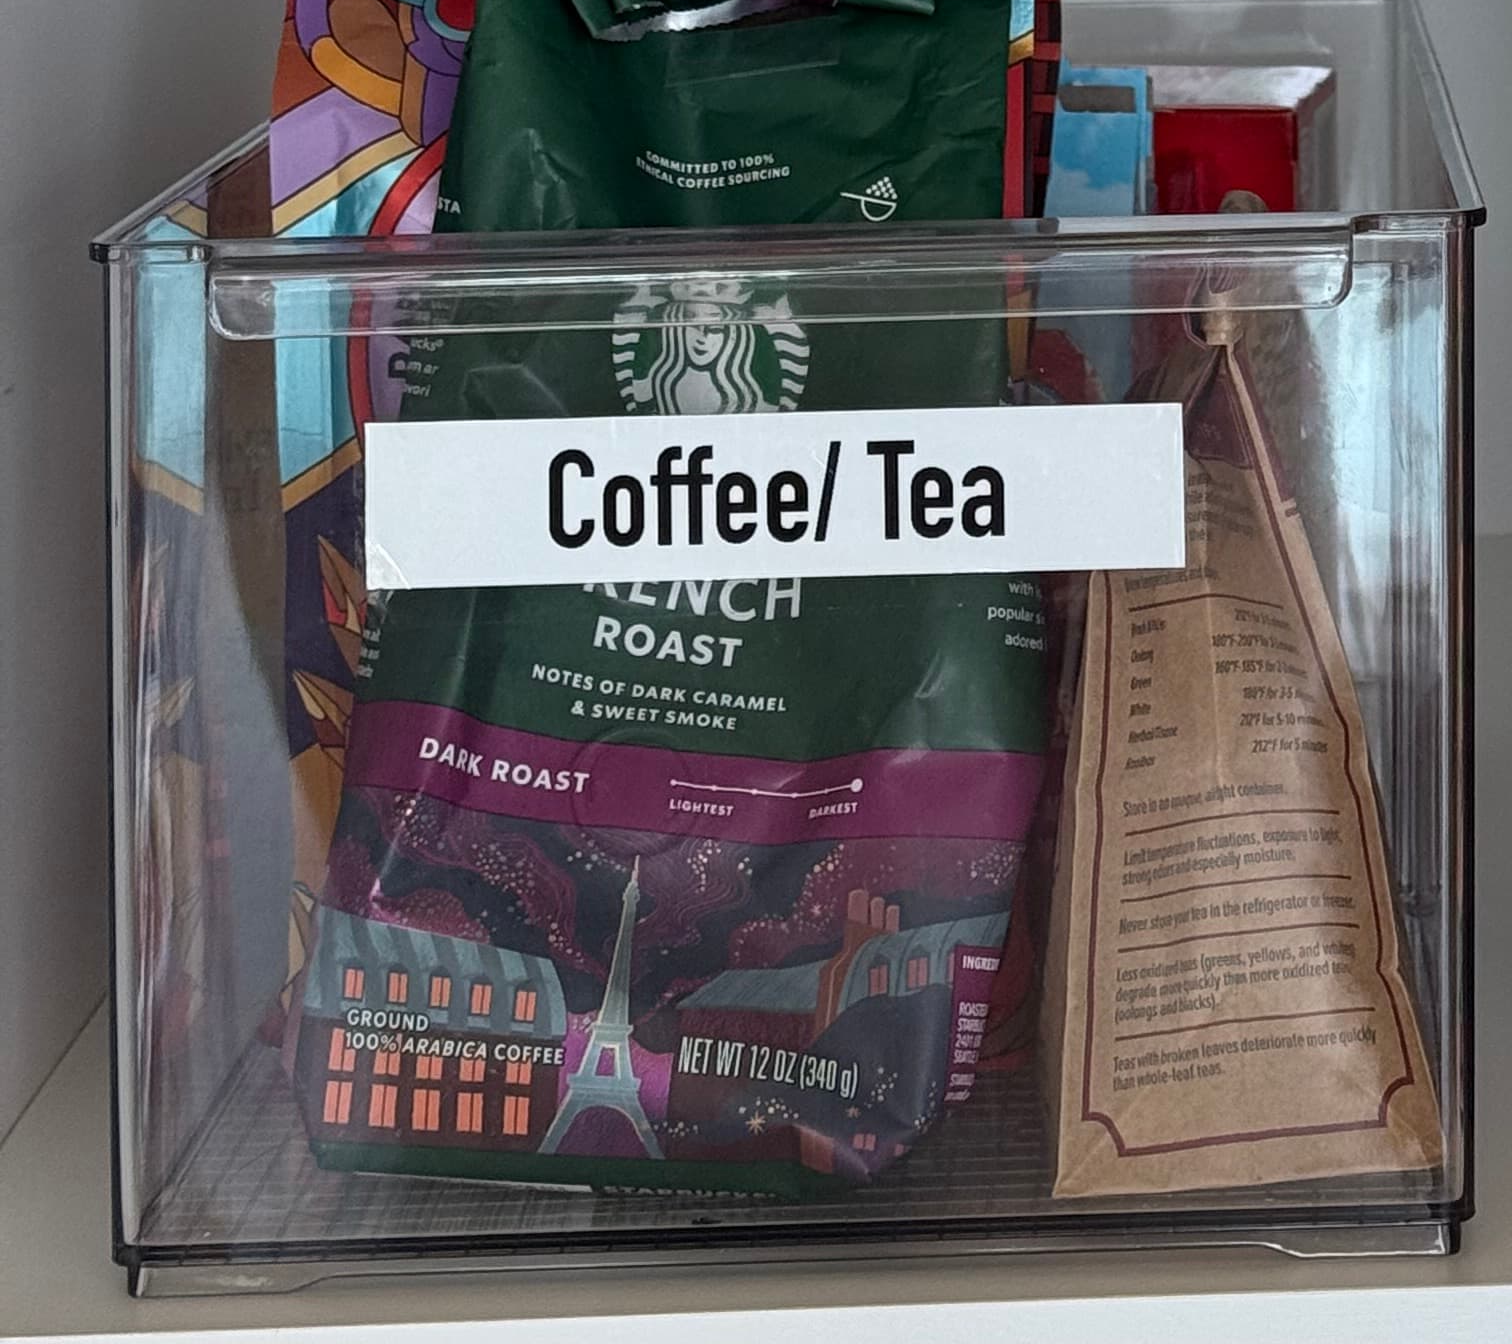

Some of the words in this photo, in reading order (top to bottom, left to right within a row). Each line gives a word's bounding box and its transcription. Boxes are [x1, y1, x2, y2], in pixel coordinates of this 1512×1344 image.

[646, 150, 719, 175] COMMITTED
[722, 158, 738, 172] TO
[739, 153, 775, 169] 100%
[676, 176, 726, 190] COFFEE
[727, 165, 791, 187] SOURCING
[547, 439, 842, 550] Coffee/
[866, 439, 1008, 542] Tea
[1008, 581, 1034, 597] with
[987, 604, 1034, 622] popular
[592, 615, 743, 668] ROAST
[1004, 632, 1043, 651] adored
[531, 662, 593, 693] NOTES
[599, 679, 627, 697] OF
[631, 684, 687, 703] DARK
[692, 691, 788, 713] CARAMEL
[570, 699, 586, 718] &
[591, 703, 661, 723] SWEET
[665, 709, 738, 731] SMOKE
[419, 735, 483, 777] DARK
[490, 759, 590, 794] ROAST
[669, 798, 734, 818] LIGHTEST
[808, 801, 859, 821] DARKEST
[1119, 917, 1147, 935] Never
[1222, 900, 1240, 916] the
[1242, 893, 1308, 915] refrigerator
[1117, 963, 1138, 982] Less
[1200, 951, 1246, 971] (greens,
[1248, 944, 1296, 966] yellows,
[1298, 941, 1320, 958] and
[1115, 982, 1158, 1003] degrade
[1223, 971, 1248, 987] than
[1249, 968, 1280, 984] more
[346, 1009, 429, 1032] GROUND
[345, 1031, 399, 1053] 100%
[401, 1037, 488, 1060] ARABICA
[494, 1043, 566, 1066] COFFEE
[1113, 1054, 1137, 1073] Teas
[1160, 1045, 1200, 1064] broken
[1201, 1039, 1240, 1058] leaves
[1241, 1032, 1304, 1052] deteriorate
[1306, 1029, 1338, 1047] more
[678, 1036, 714, 1076] NET
[716, 1040, 746, 1079] WT
[750, 1044, 771, 1081] 12
[773, 1049, 798, 1084] OZ
[799, 1053, 838, 1091] (340
[840, 1062, 859, 1100] g)
[1113, 1071, 1137, 1092] than
[1136, 1065, 1195, 1088] whole-leaf
